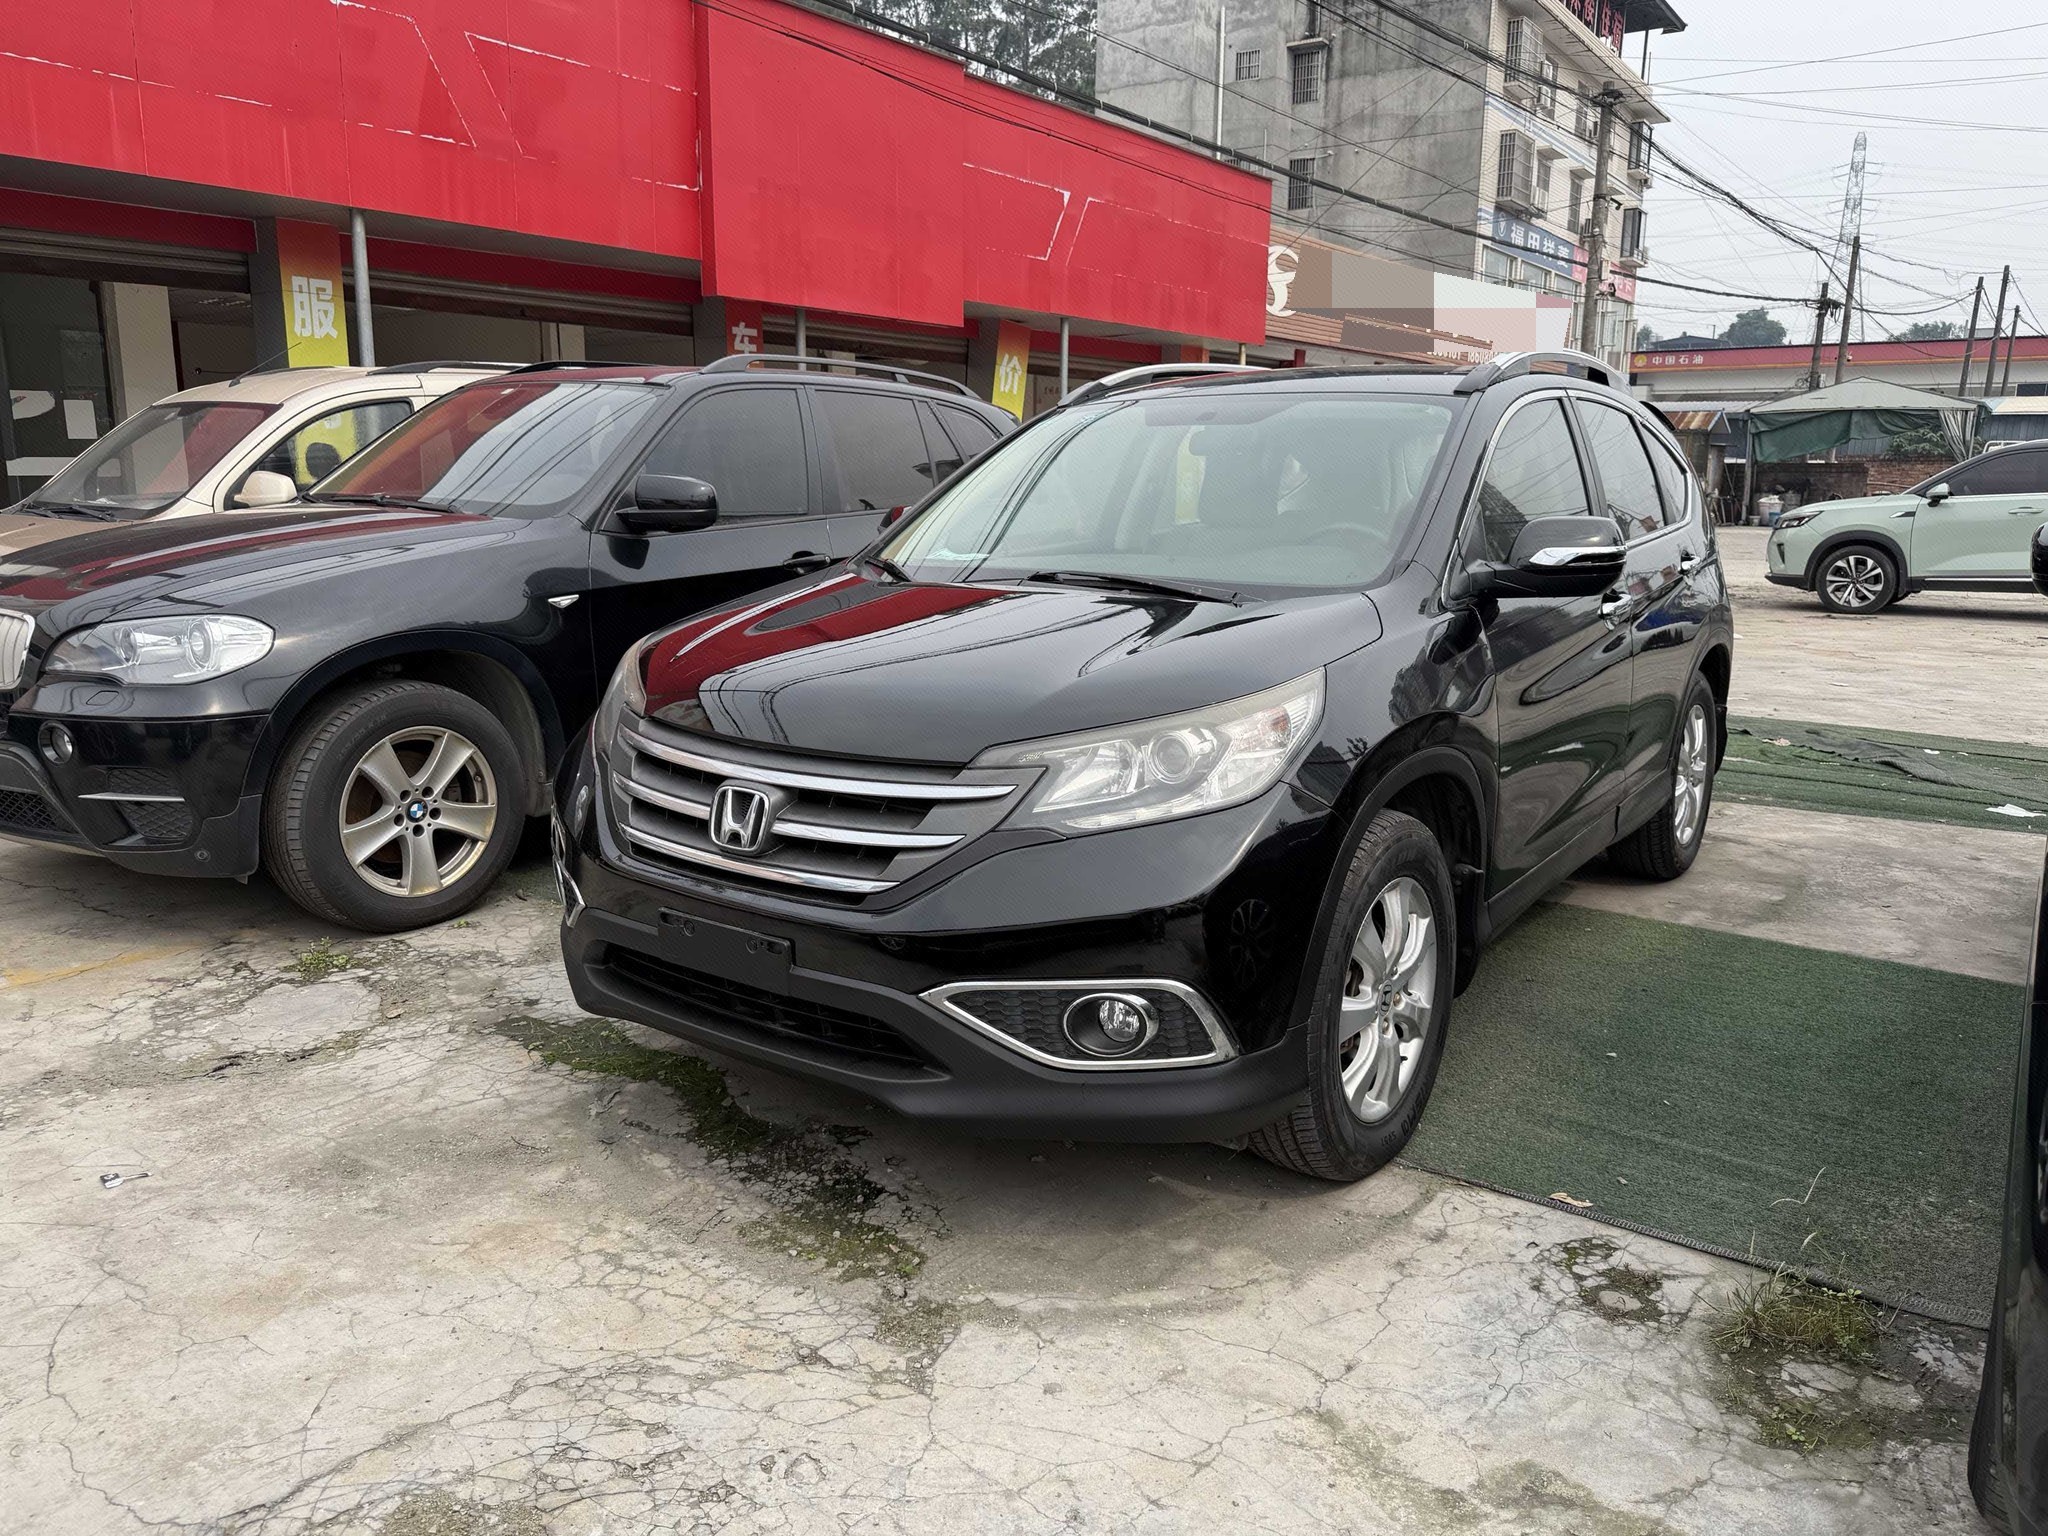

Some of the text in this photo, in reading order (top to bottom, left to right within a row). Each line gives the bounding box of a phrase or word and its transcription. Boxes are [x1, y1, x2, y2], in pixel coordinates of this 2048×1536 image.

[291, 275, 338, 339] 服
[731, 321, 758, 354] 车
[999, 353, 1023, 395] 价
[1652, 354, 1704, 366] 中国石油
